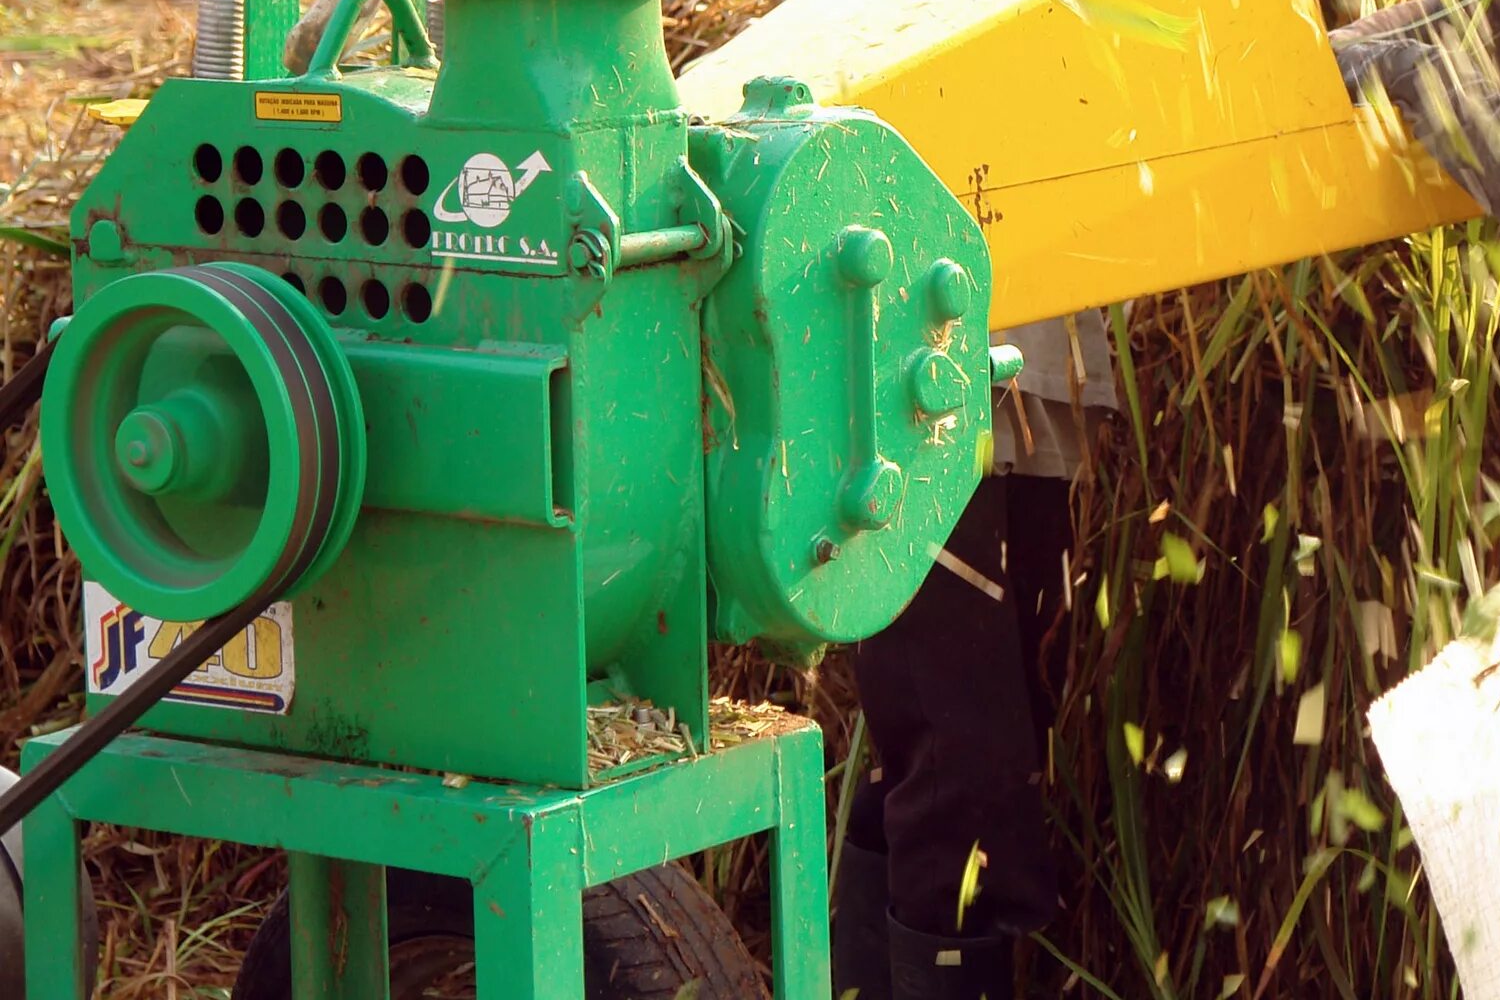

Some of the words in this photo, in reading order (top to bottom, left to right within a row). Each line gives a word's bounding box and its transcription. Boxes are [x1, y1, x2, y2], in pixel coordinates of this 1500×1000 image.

[432, 231, 511, 254] PROTEC
[520, 236, 558, 258] S.A.
[93, 603, 145, 690] JF
